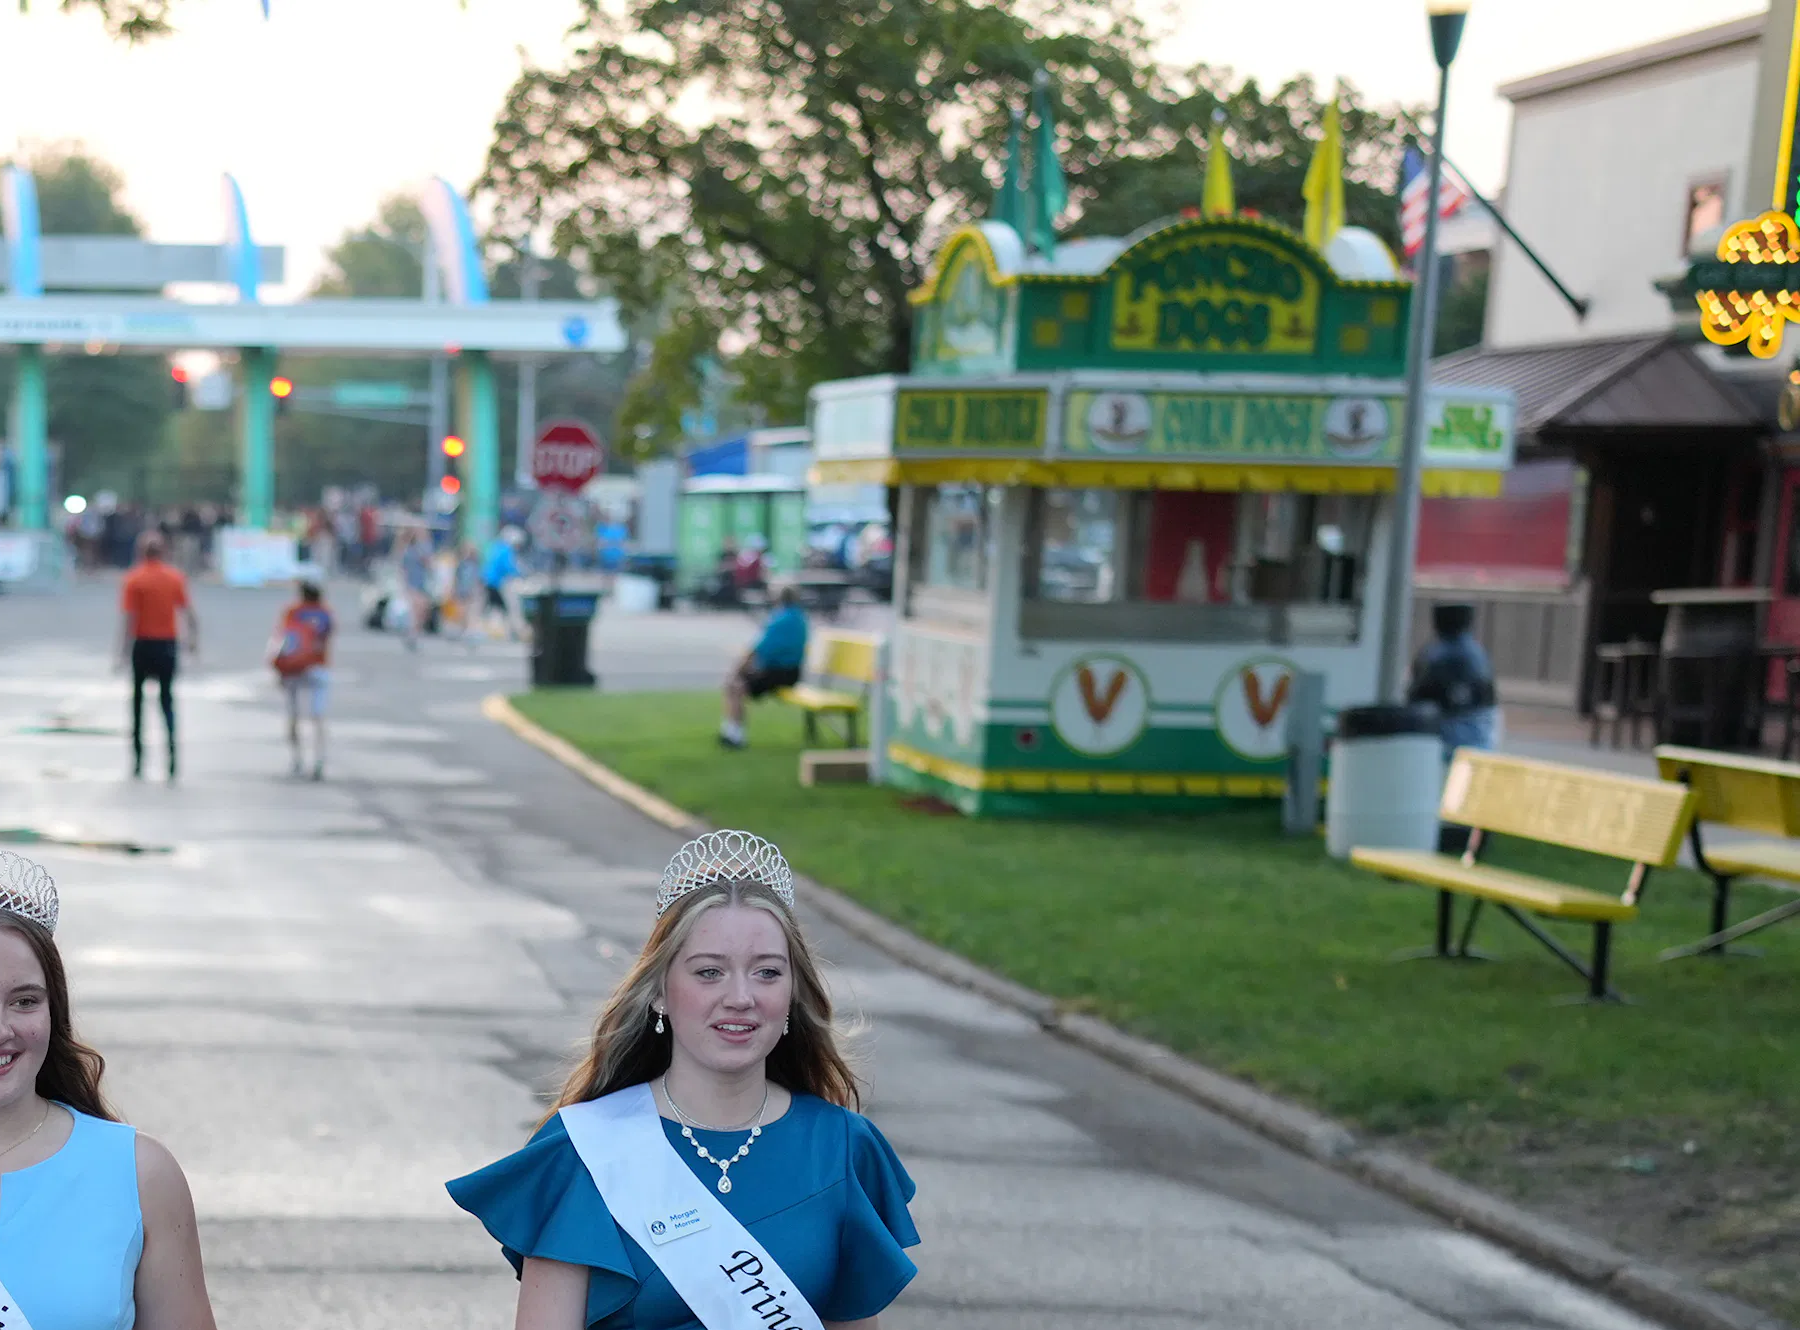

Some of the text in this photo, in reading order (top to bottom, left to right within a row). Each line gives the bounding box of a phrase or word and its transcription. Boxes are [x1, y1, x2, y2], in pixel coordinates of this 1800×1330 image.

[1157, 301, 1272, 348] DOGS
[1163, 398, 1312, 452] CORN DOGS
[536, 443, 600, 478] STOP
[669, 1208, 698, 1221] Morgan
[674, 1218, 700, 1229] Morrow
